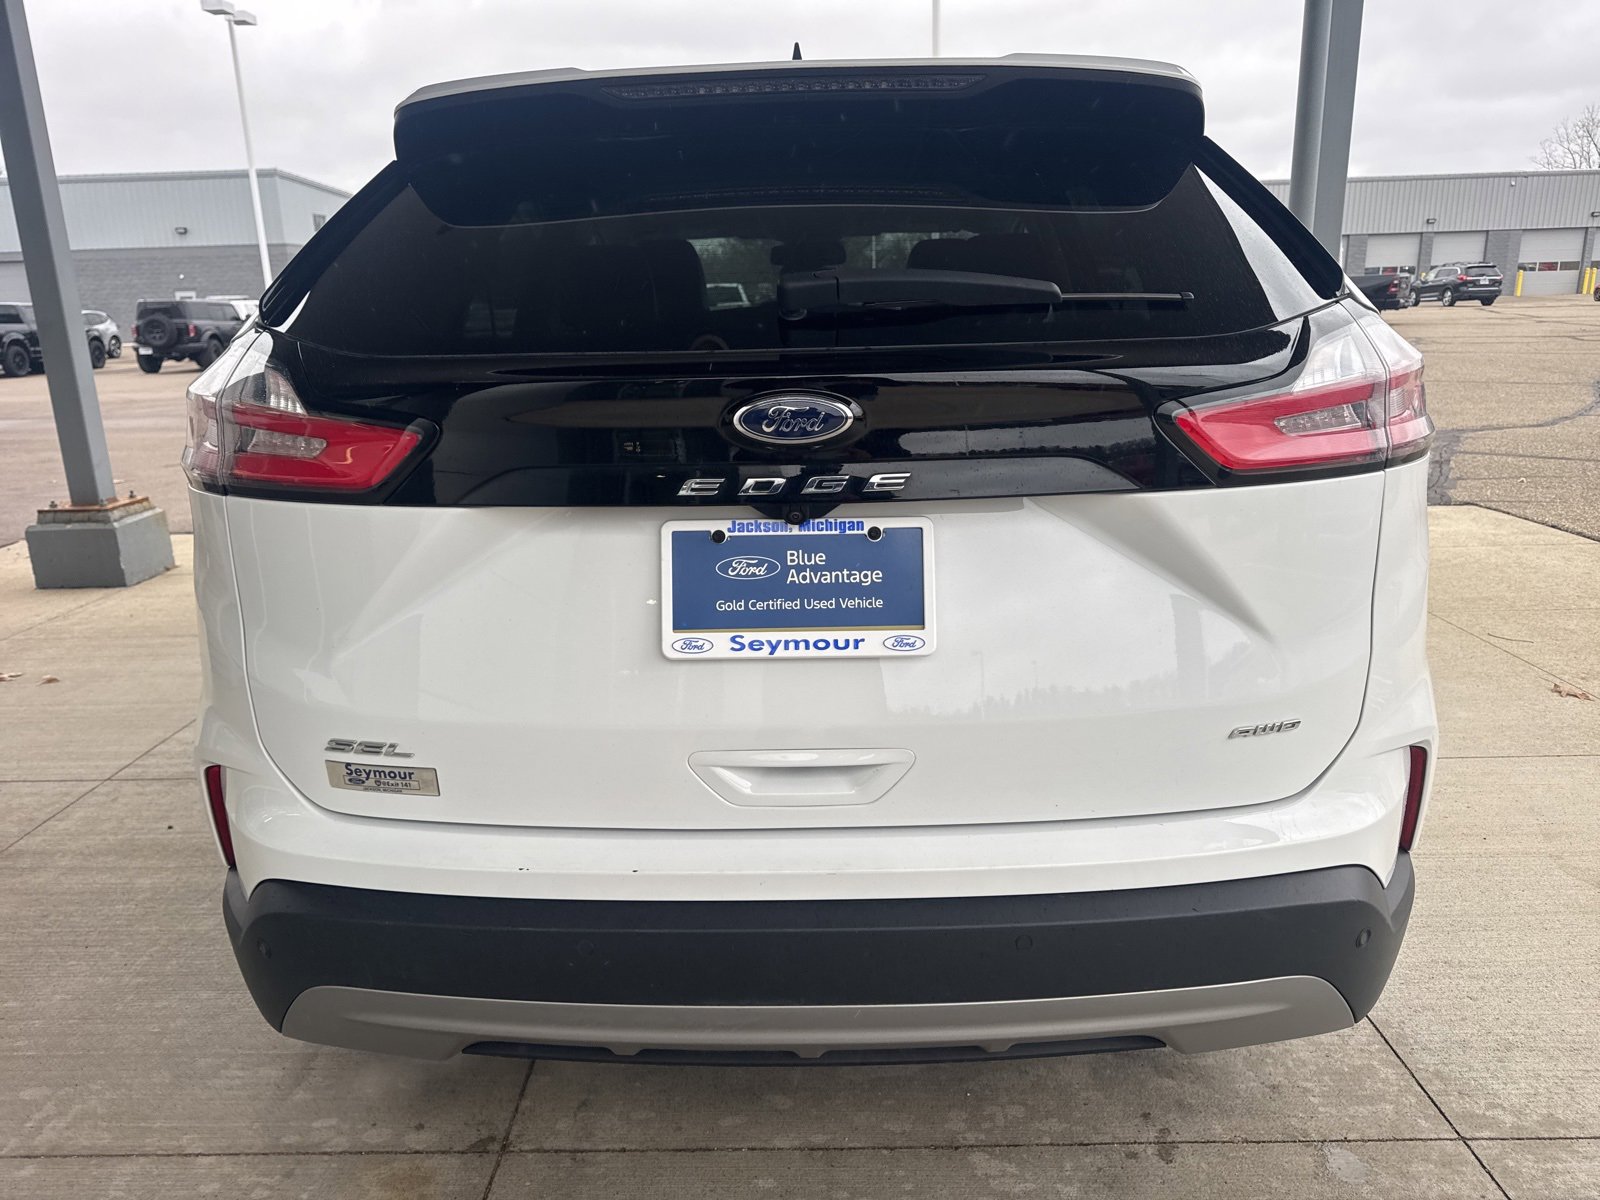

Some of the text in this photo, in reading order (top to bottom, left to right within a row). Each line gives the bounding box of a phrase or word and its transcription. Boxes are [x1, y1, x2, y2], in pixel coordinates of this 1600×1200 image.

[761, 405, 826, 433] Ford
[676, 472, 912, 496] EDGE
[799, 519, 865, 533] Michigan
[786, 550, 826, 566] Blue
[728, 560, 768, 577] Ford
[786, 568, 883, 586] Advantage
[715, 597, 884, 611] Gold Certified Used Vehicle
[680, 639, 705, 651] Ford
[729, 634, 866, 656] Seymour
[891, 637, 917, 649] Ford
[324, 738, 415, 758] SEL
[344, 762, 415, 780] Seymour
